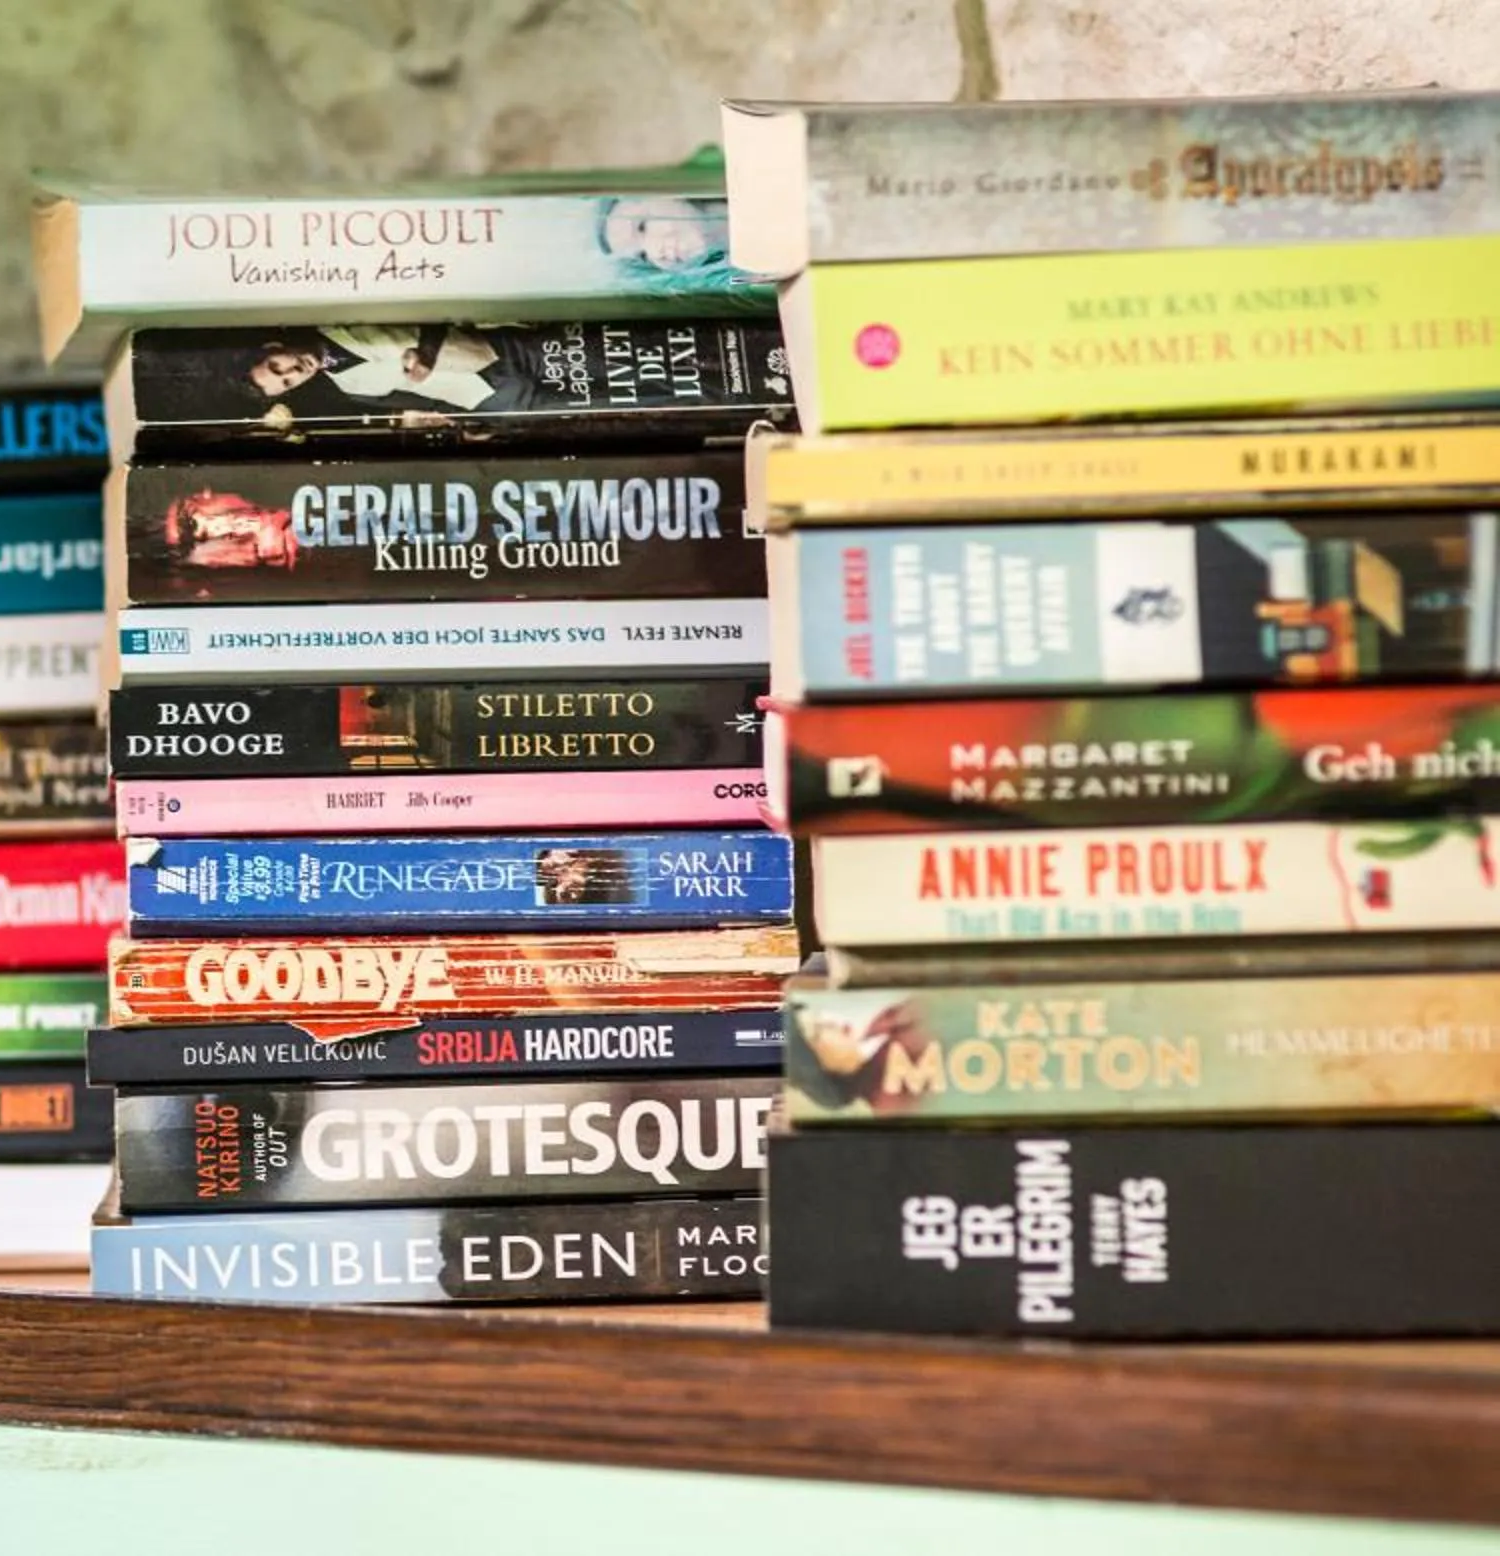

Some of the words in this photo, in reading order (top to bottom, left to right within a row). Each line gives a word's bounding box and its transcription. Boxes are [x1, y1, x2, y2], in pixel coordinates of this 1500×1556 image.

[166, 213, 273, 260] JODI
[300, 208, 504, 246] PICOULT
[230, 253, 359, 290] Vanishing
[375, 249, 446, 282] Acts
[542, 340, 566, 392] Jens
[564, 322, 595, 407] Lapidus
[602, 325, 639, 404] LIVET
[636, 345, 667, 381] DE
[667, 327, 703, 398] LUXE
[937, 344, 1035, 377] KEIN
[1048, 330, 1236, 370] SOMMER
[1252, 322, 1369, 358] OHNE
[291, 482, 480, 547] GERALD
[492, 476, 722, 541] SEYMOUR
[373, 535, 488, 580] Killing
[498, 533, 621, 569] Ground
[208, 629, 387, 649] VORTREFFLICHKEIT
[393, 630, 429, 646] DER
[435, 627, 484, 644] JOCH
[491, 627, 560, 643] SANFTE
[567, 627, 605, 641] DAS
[623, 626, 665, 641] FEYL
[672, 625, 742, 640] RENATE
[158, 702, 251, 725] BAVO
[477, 693, 654, 718] STILETTO
[126, 733, 285, 757] DHOOGE
[479, 733, 655, 757] LIBRETTO
[951, 741, 1194, 770] MARGARET
[1303, 741, 1396, 783] Geh
[326, 792, 385, 809] HARRIET
[952, 773, 1230, 802] MAZZANTINI
[322, 862, 528, 900] RENEGADE
[659, 851, 752, 874] SARAH
[918, 845, 1061, 900] ANNIE
[1086, 839, 1267, 896] PROULX
[673, 876, 747, 897] PARR
[185, 945, 456, 1009] GOODBYE
[977, 1001, 1107, 1038] KATE
[183, 1042, 257, 1065] DUŠAN
[417, 1034, 518, 1063] SRBIJA
[524, 1025, 674, 1061] HARDCORE
[883, 1036, 1200, 1095] MORTON
[253, 1113, 265, 1129] OF
[196, 1100, 218, 1197] NATSUO
[219, 1105, 240, 1191] KIRINO
[254, 1133, 267, 1182] AUTHOR
[268, 1126, 287, 1167] OUT
[300, 1097, 771, 1185] GROTESQUE
[677, 1225, 758, 1247] MAR
[903, 1196, 958, 1272] JEG
[961, 1205, 1015, 1258] ER
[1015, 1140, 1074, 1322] PILEGRIM
[1120, 1177, 1168, 1282] HAYES
[130, 1237, 436, 1293] INVISIBLE
[462, 1231, 637, 1281] EDEN
